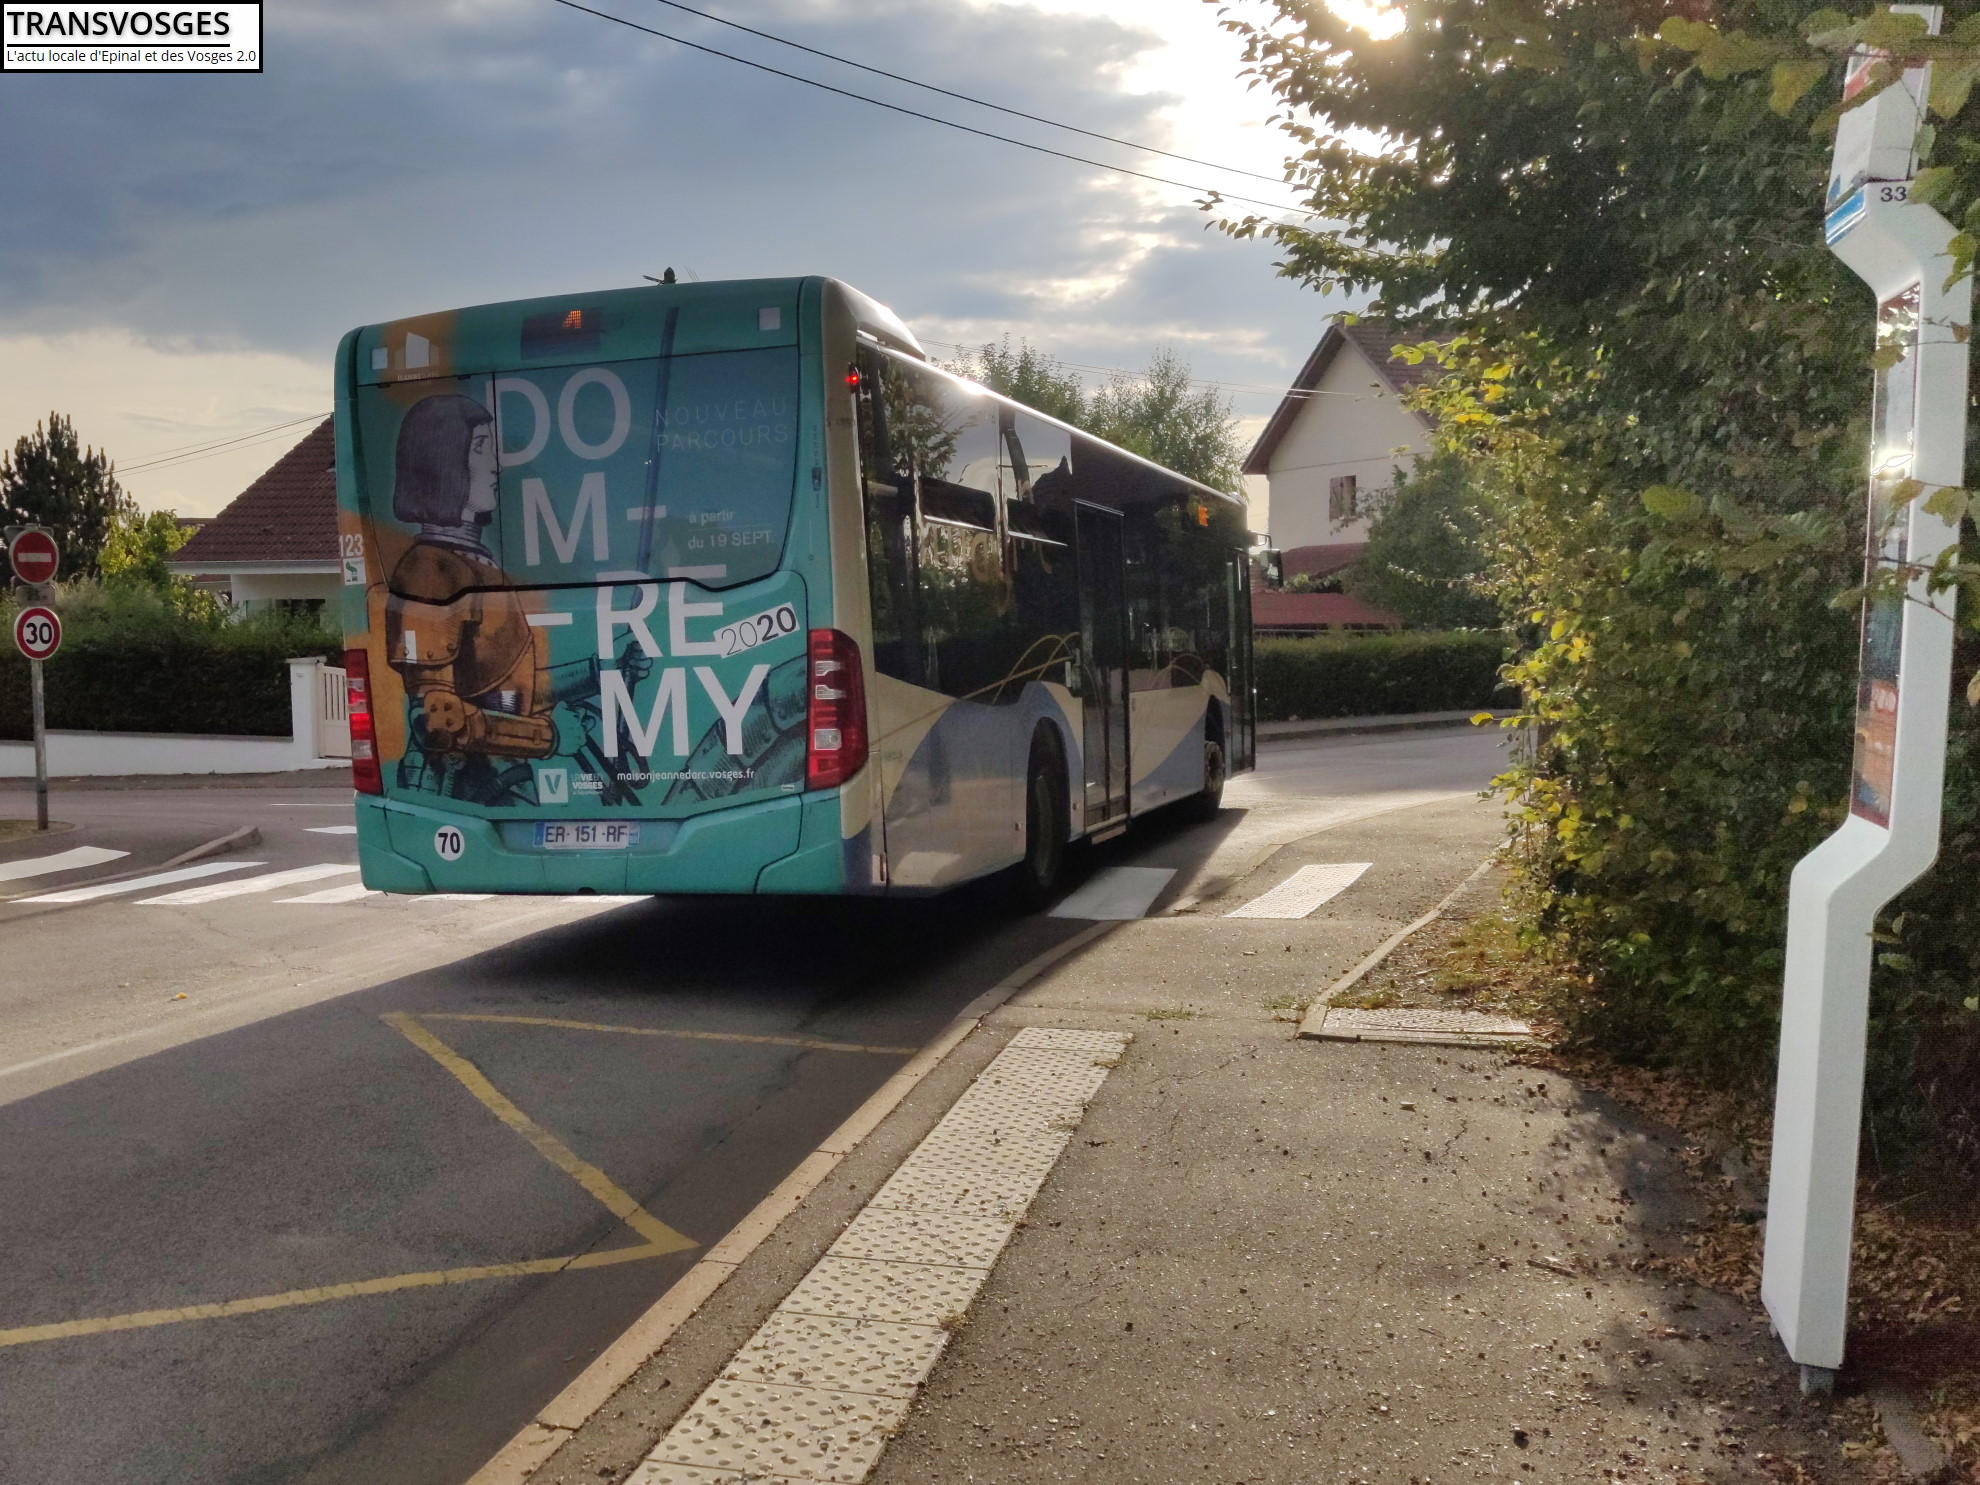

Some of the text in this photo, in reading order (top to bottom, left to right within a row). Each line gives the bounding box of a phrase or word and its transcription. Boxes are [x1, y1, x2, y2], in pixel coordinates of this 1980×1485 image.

[1880, 186, 1907, 203] 33
[485, 367, 632, 468] DO
[655, 397, 787, 427] NOUVEAU
[656, 422, 789, 453] PARCOURS
[701, 508, 735, 527] partir
[339, 533, 364, 557] 123
[687, 534, 704, 550] du
[710, 533, 728, 548] 19
[25, 622, 53, 645] 30
[721, 606, 797, 656] 2020
[599, 664, 771, 758] MY
[572, 781, 603, 790] VOSGES
[617, 768, 755, 783] maisonjeannedarc.vosges.fr
[437, 831, 462, 855] 70
